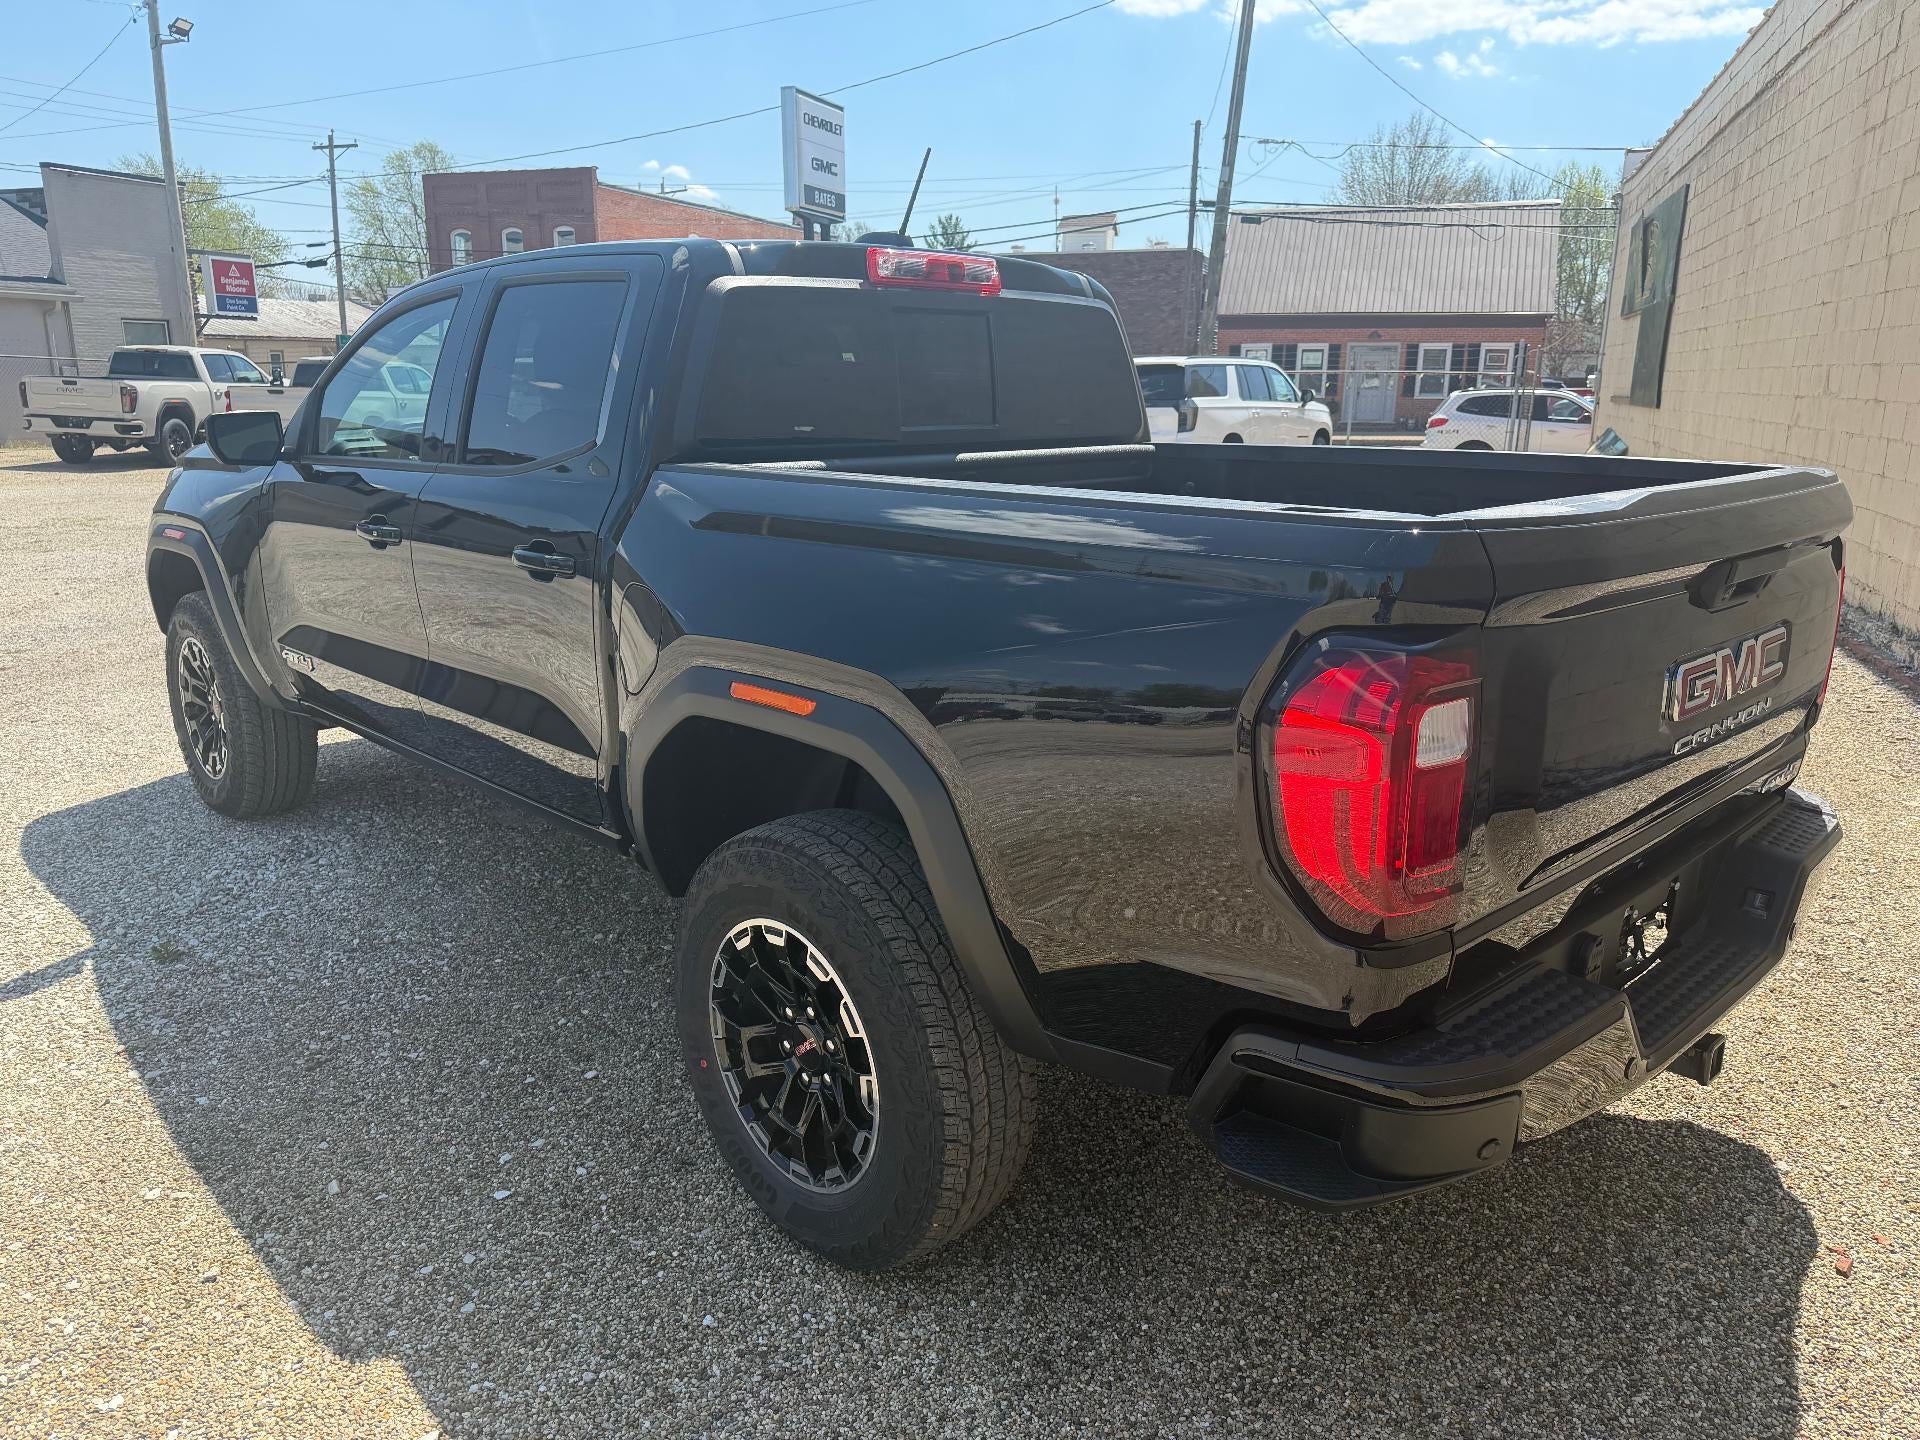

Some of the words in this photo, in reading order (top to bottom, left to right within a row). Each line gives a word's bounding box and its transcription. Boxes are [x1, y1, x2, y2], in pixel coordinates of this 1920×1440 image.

[803, 112, 843, 136] CHEVROLET
[811, 156, 838, 177] GMC
[814, 190, 836, 208] BATES
[220, 276, 249, 286] Benjamin
[226, 284, 246, 293] Moore
[1662, 626, 1787, 721] GMC
[1671, 697, 1772, 755] CANYON
[795, 1037, 817, 1057] GMC
